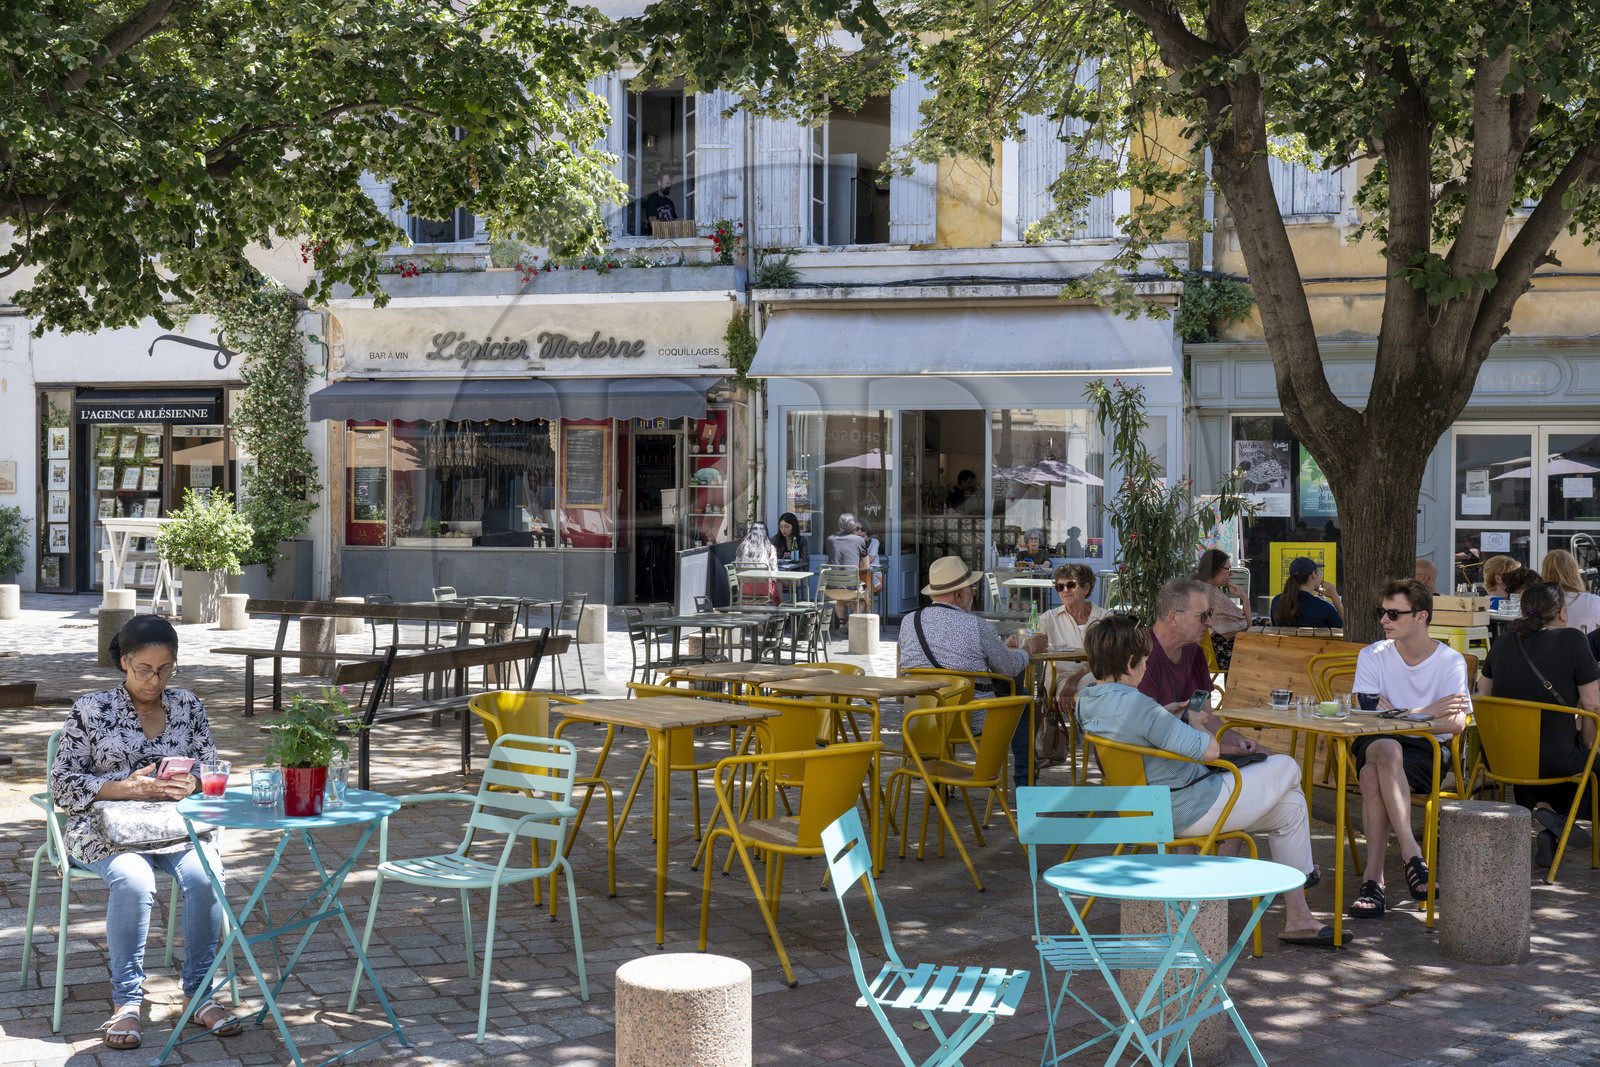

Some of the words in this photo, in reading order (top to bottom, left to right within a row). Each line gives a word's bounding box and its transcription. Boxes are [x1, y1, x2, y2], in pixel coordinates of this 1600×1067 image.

[537, 332, 646, 360] Moderne
[369, 351, 386, 360] BAR
[387, 349, 395, 360] À
[394, 350, 409, 360] VIN
[658, 347, 720, 358] COQUILLAGES
[80, 409, 136, 420] L'AGENCE
[136, 407, 209, 420] ARLÉSIENNE
